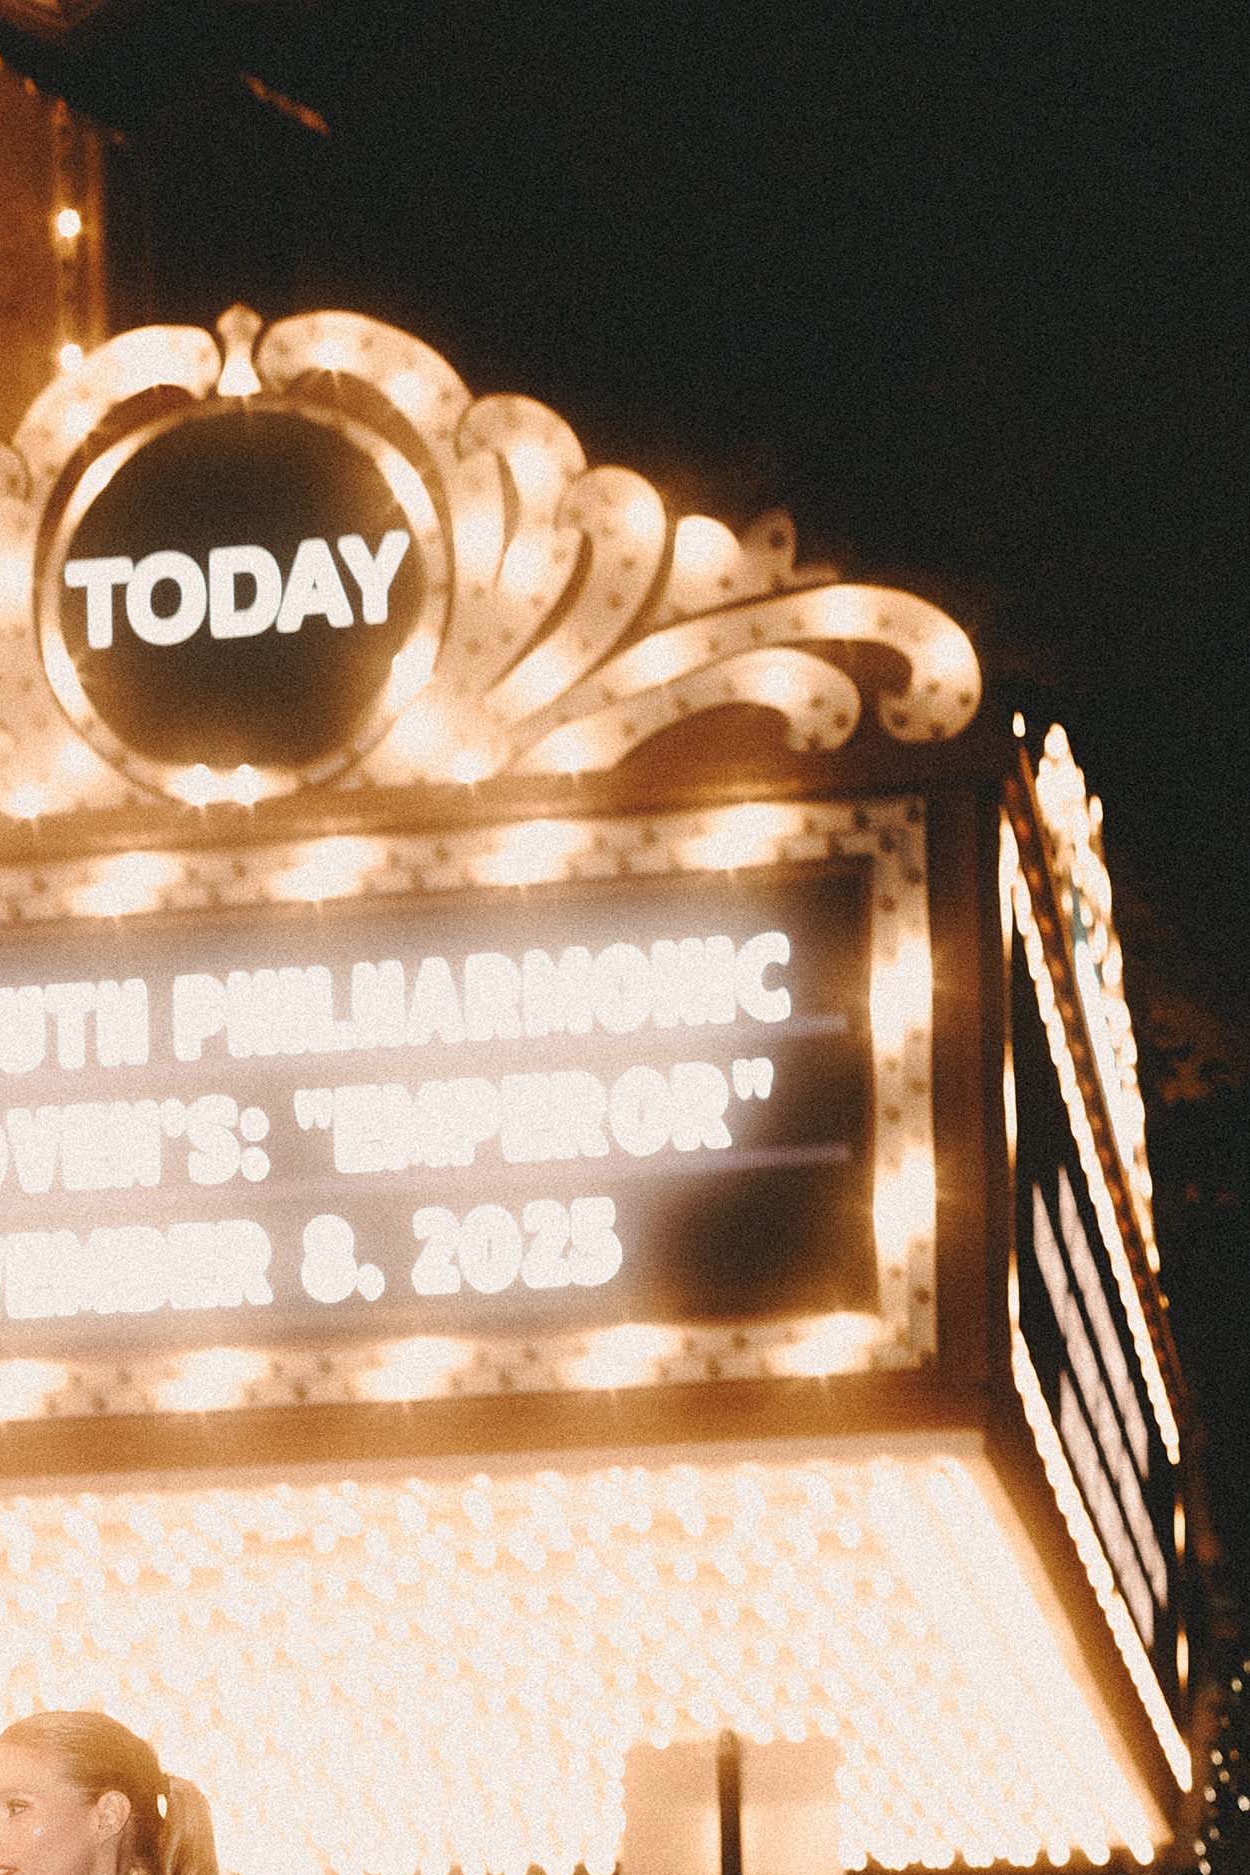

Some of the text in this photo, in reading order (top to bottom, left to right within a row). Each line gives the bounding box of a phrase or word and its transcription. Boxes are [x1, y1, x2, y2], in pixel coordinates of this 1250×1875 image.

[64, 531, 411, 650] TODAY
[172, 931, 792, 1062] PHILHARMONIC
[294, 1057, 775, 1174] "EMPEROR"
[411, 1196, 623, 1296] 2025
